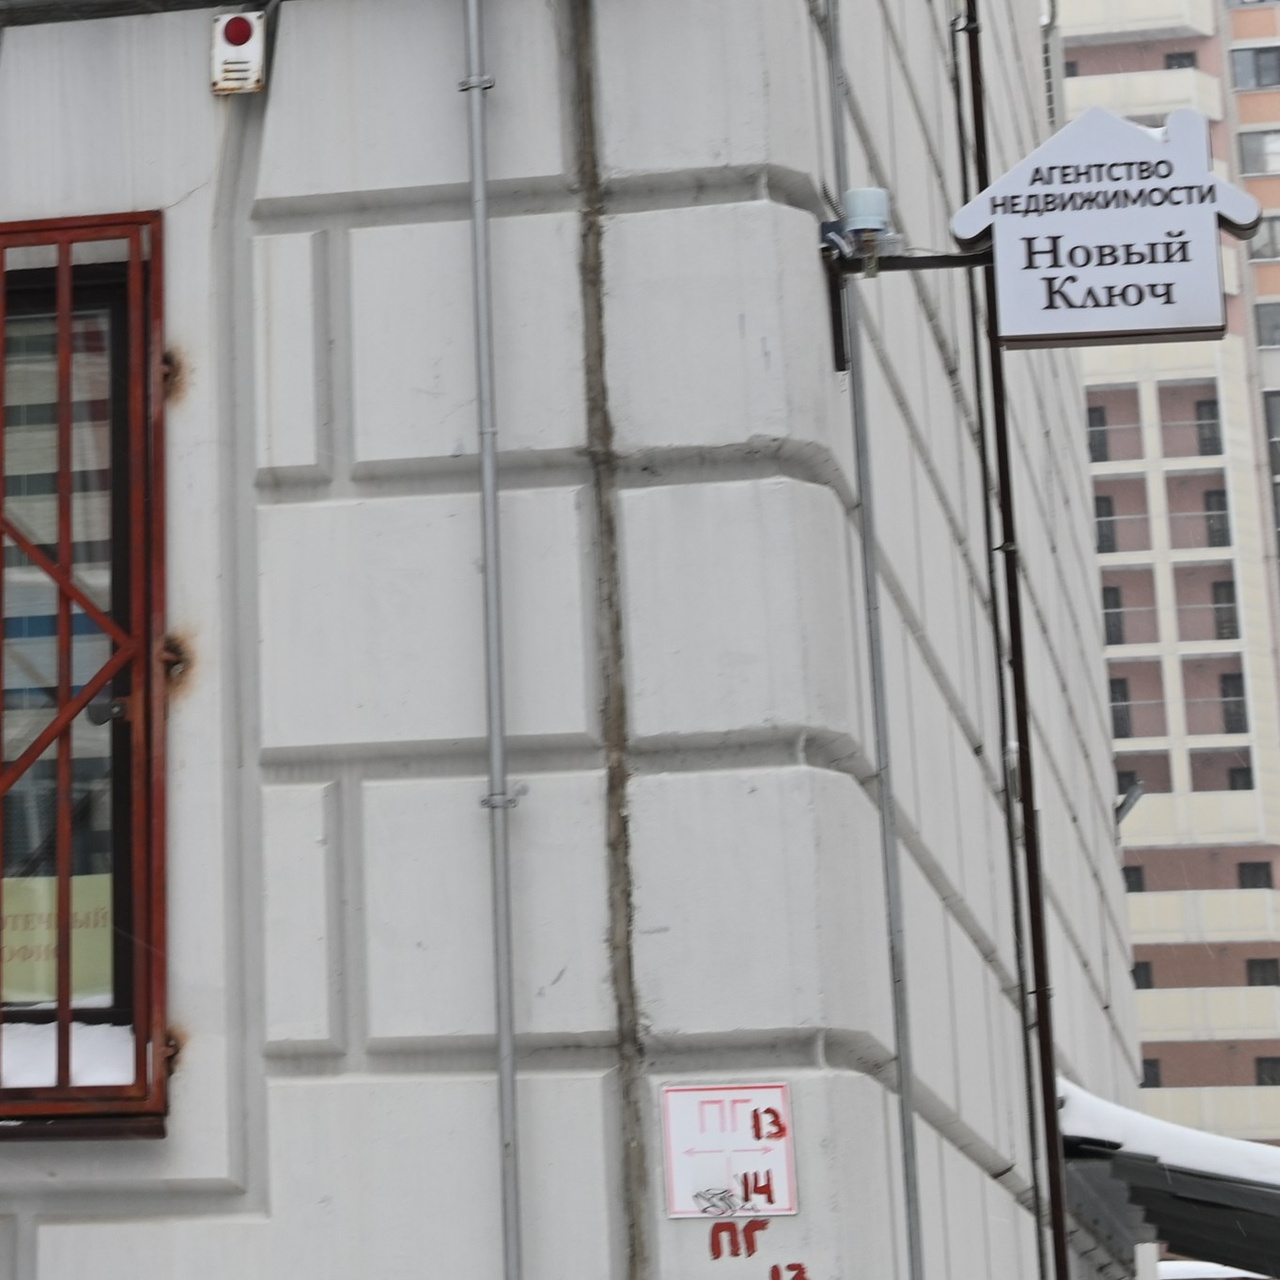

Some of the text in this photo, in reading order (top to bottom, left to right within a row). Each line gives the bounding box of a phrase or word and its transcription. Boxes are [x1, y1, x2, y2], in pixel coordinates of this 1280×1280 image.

[1029, 160, 1174, 187] АГЕНТСТВО
[990, 184, 1217, 217] НЕДВИЖИМОСТИ
[1020, 230, 1192, 270] Новый
[1040, 275, 1177, 311] Ключ
[698, 1098, 752, 1133] ПГ
[752, 1107, 787, 1140] 13
[742, 1169, 775, 1205] 14
